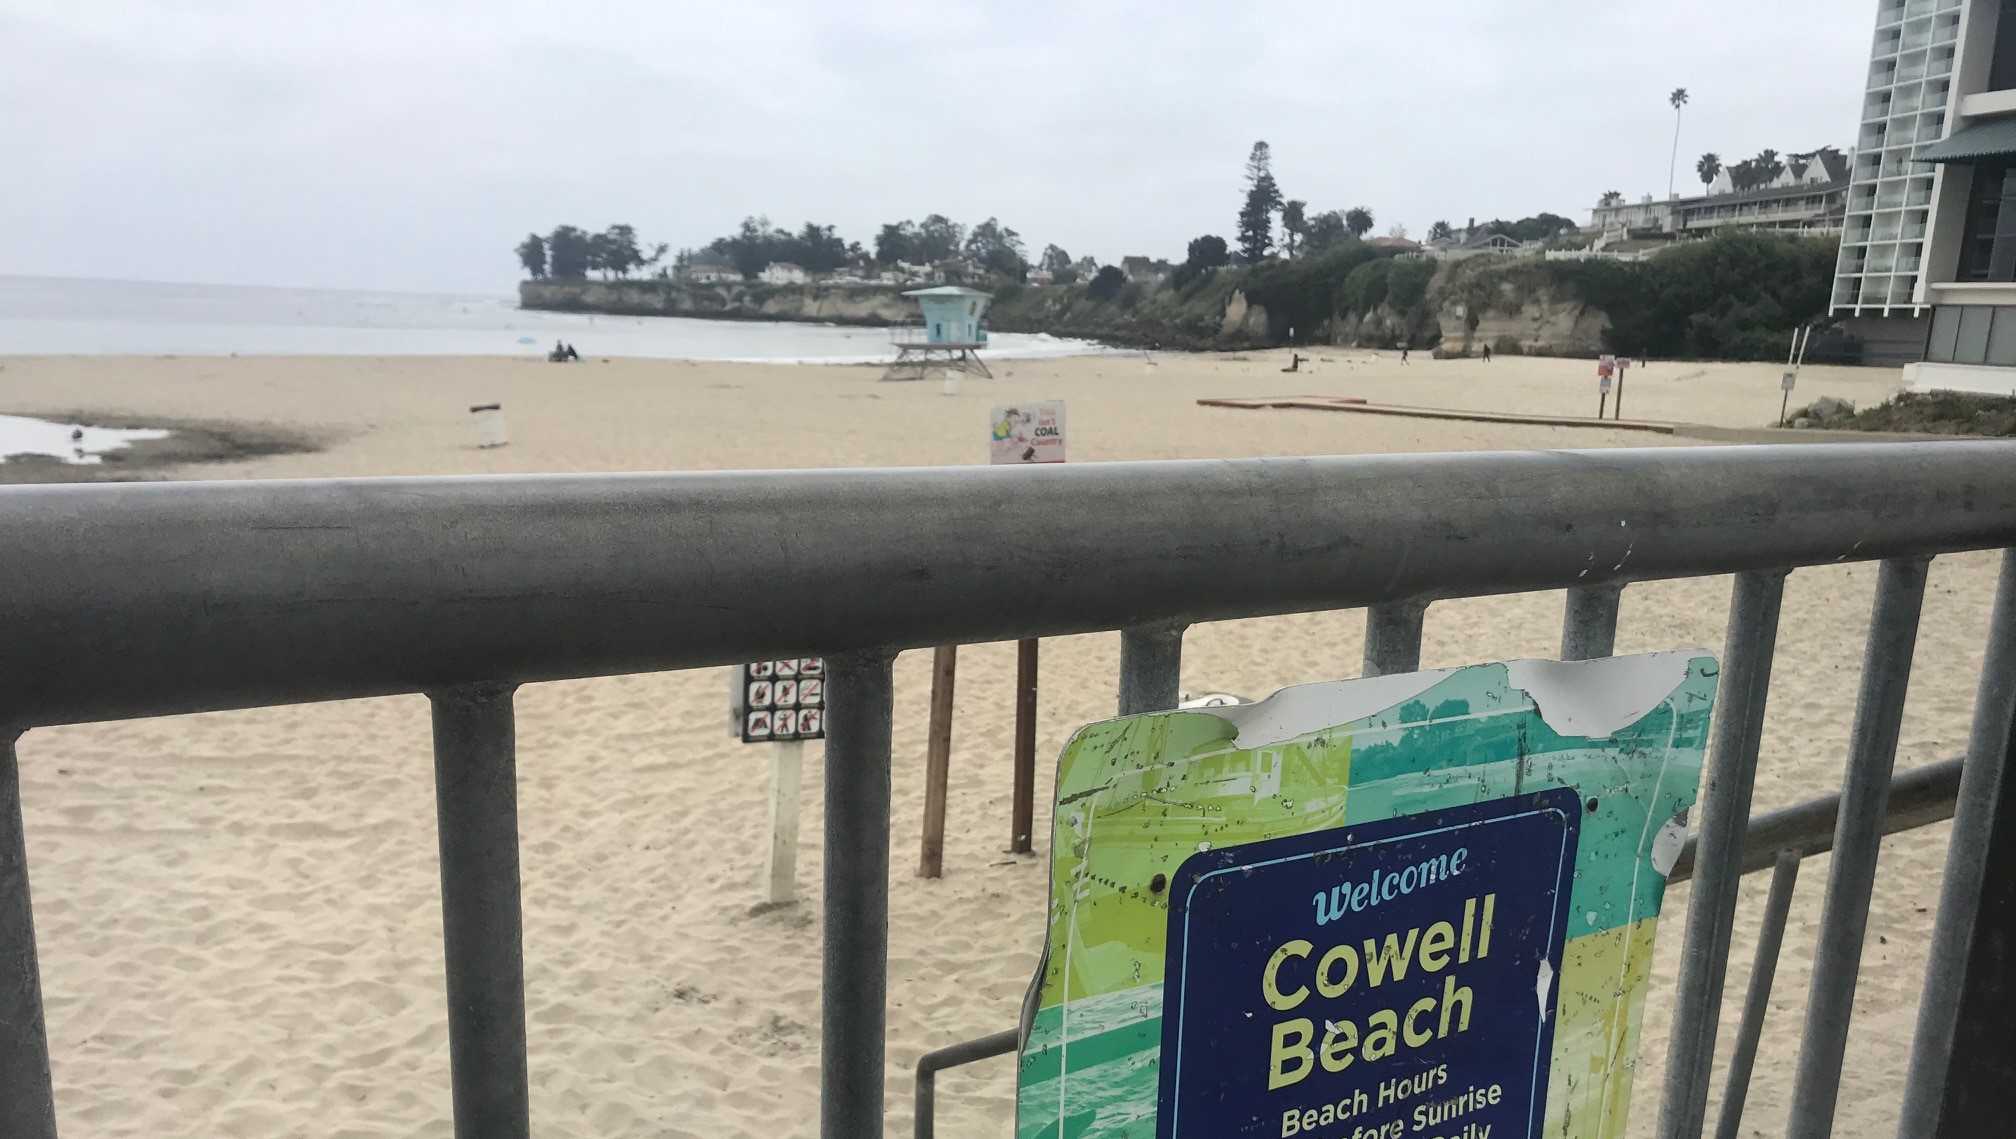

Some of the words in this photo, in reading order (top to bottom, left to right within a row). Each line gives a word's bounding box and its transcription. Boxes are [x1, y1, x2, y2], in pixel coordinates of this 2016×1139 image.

[1034, 426, 1059, 437] COAL
[1262, 893, 1496, 1011] Cowell
[1269, 975, 1474, 1090] Beach
[1281, 1088, 1368, 1138] Beach
[1378, 1063, 1448, 1108] Hours
[1412, 1083, 1502, 1132] Sunrise
